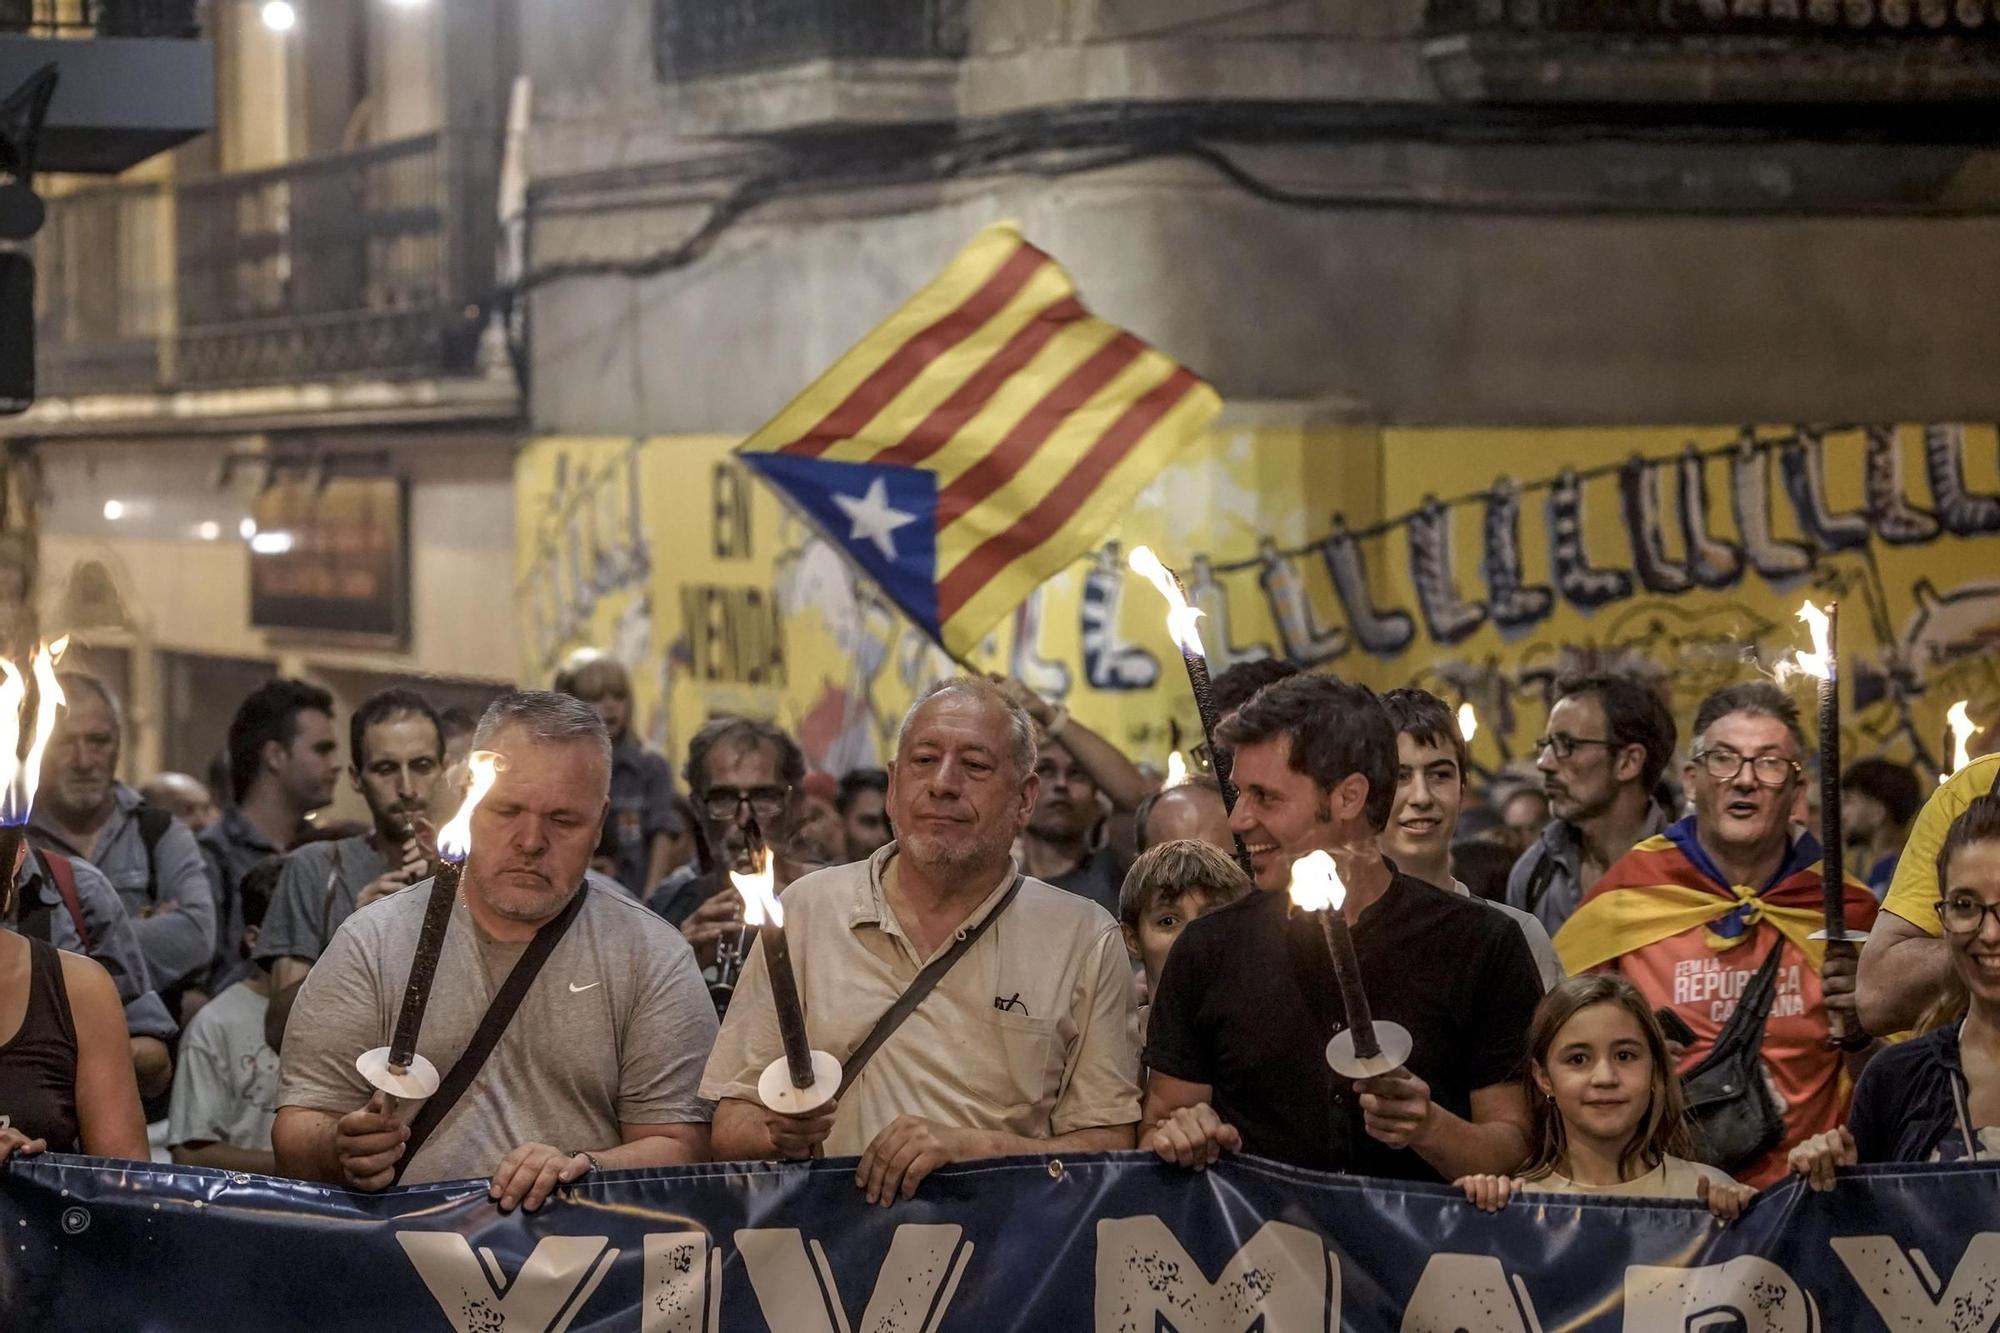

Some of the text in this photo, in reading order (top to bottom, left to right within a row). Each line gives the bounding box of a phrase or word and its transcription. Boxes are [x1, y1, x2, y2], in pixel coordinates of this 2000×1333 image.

[1676, 958, 1720, 977] FEM LA
[1675, 965, 1800, 1004] REPÚBCA
[1711, 994, 1805, 1022] CAANA
